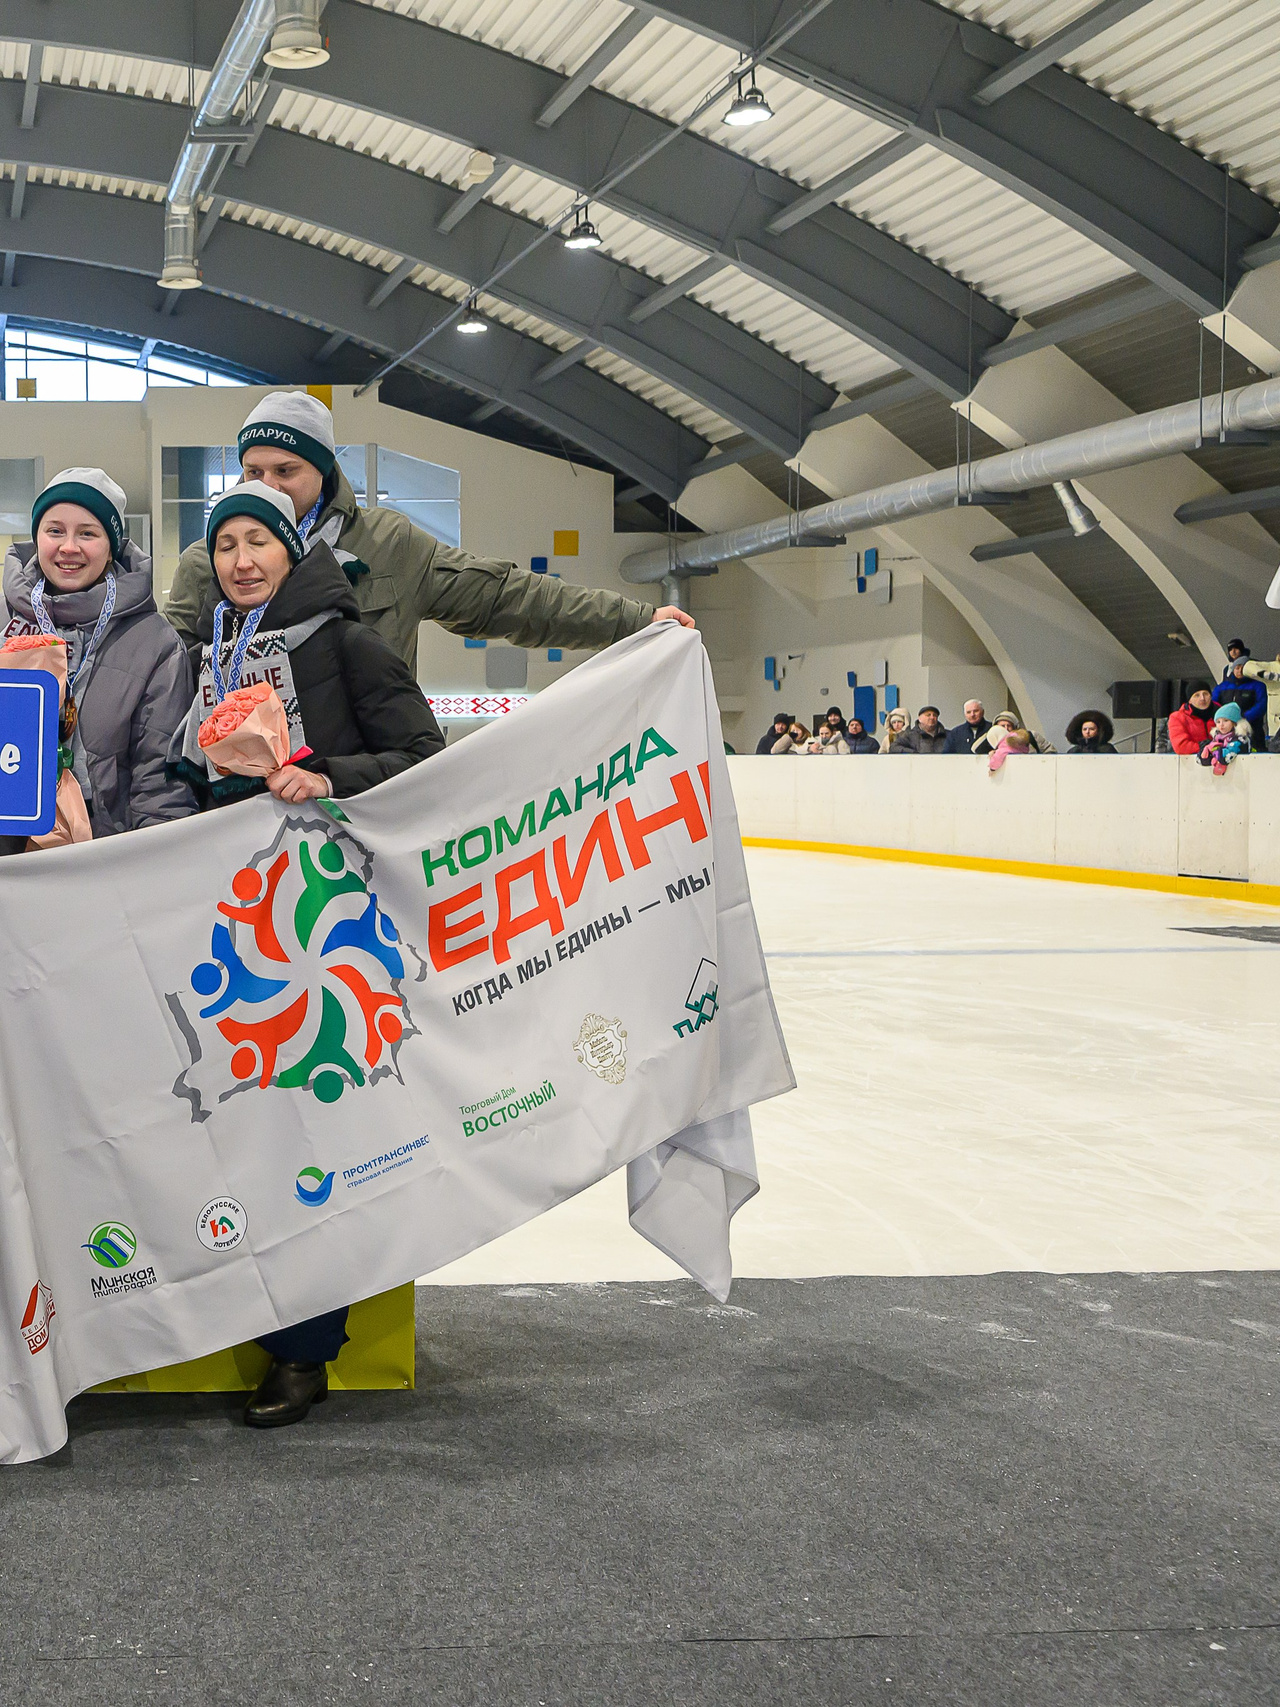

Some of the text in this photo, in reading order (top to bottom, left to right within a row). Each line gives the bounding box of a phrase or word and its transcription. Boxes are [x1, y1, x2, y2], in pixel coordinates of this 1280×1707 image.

[240, 427, 297, 446] БЕЛАРУСЬ
[421, 726, 679, 888] КОМАНДА
[451, 972, 514, 1017] КОГДА
[516, 949, 553, 985] МЫ
[555, 905, 633, 962] ЕДИНЫ
[665, 867, 711, 904] МЫ
[459, 1086, 517, 1115] Торговый Дом
[462, 1079, 557, 1138] ВОСТОЧНЫЙ
[346, 1156, 414, 1189] страховая компания
[200, 1201, 240, 1229] БЕЛОРУССКИЕ
[90, 1266, 155, 1292] Минская
[93, 1276, 158, 1299] типография
[27, 1329, 47, 1351] ДОМ
